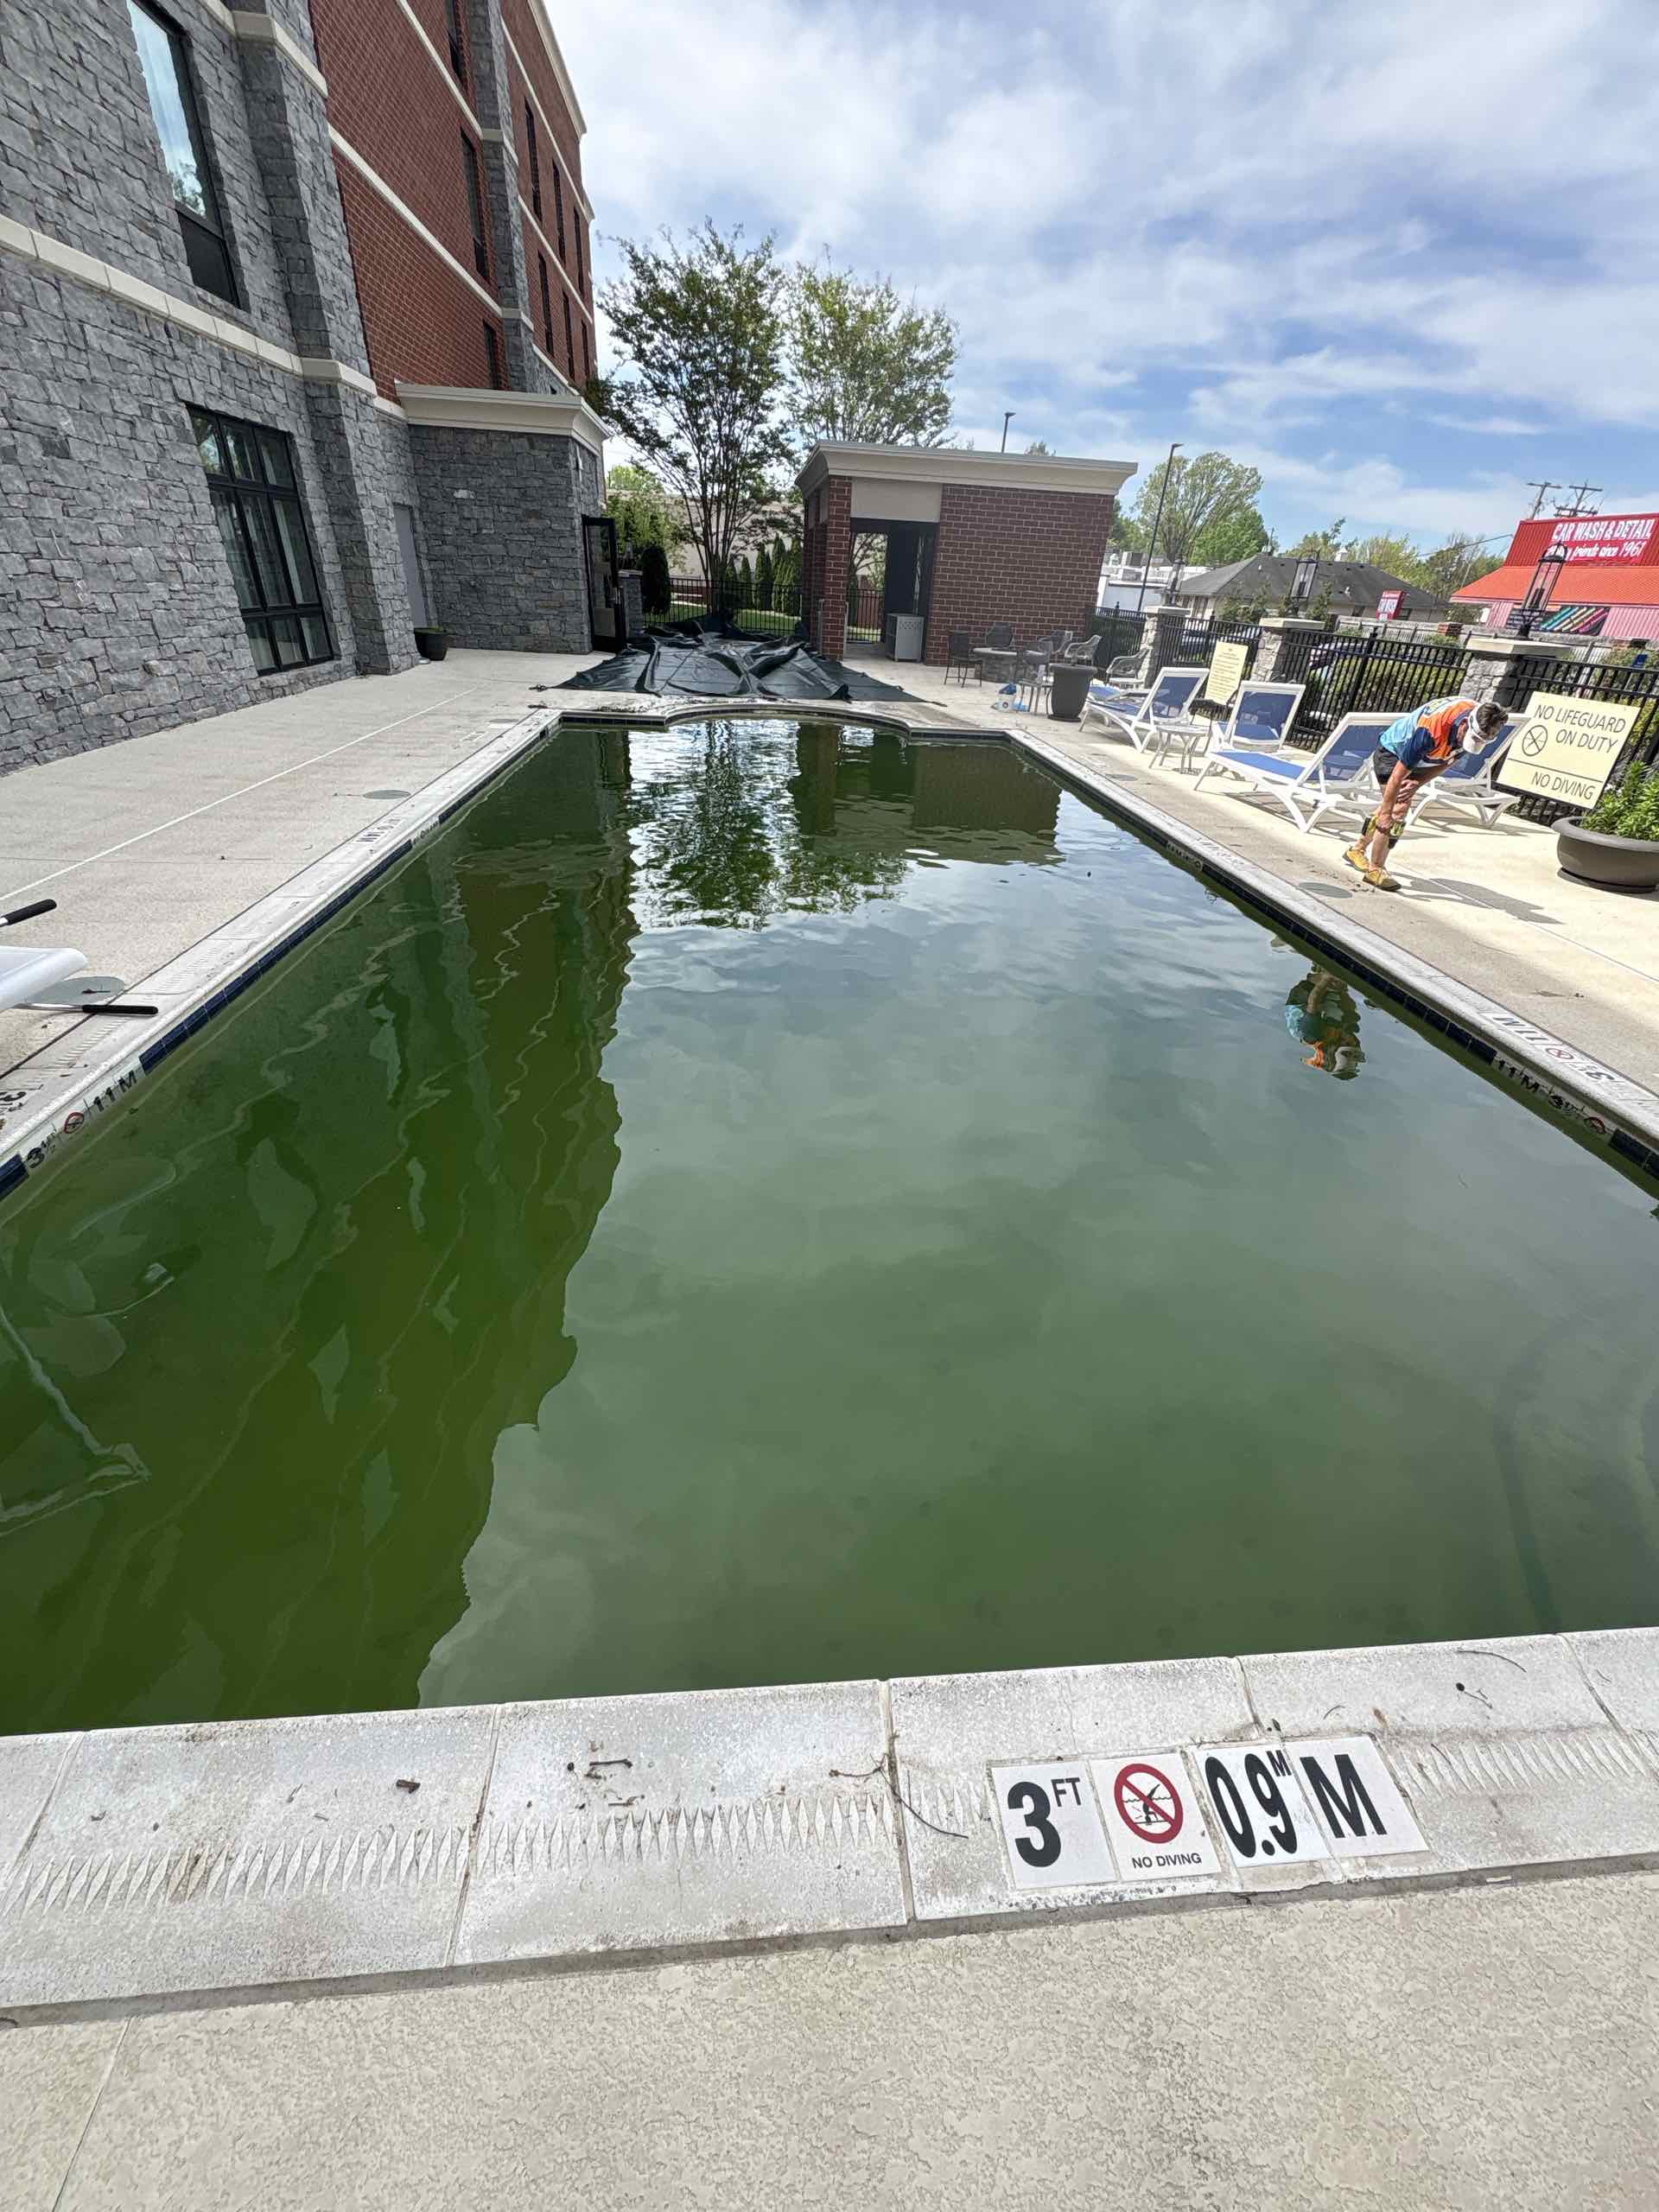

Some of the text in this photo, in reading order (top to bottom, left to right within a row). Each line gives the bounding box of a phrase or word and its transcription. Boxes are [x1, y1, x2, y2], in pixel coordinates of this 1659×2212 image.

[1552, 522, 1574, 541] CAR
[1574, 521, 1608, 541] WASH
[1613, 518, 1656, 540] DETAIL
[1619, 541, 1646, 557] 1961
[1534, 704, 1626, 733] NO LIFEGUARD
[1555, 728, 1618, 753] ON DUTY
[1531, 772, 1596, 800] NO DIVING
[1007, 1781, 1061, 1867] 3
[1051, 1777, 1082, 1808] FT
[1300, 1753, 1388, 1839] M
[1131, 1853, 1202, 1869] NO DIVING
